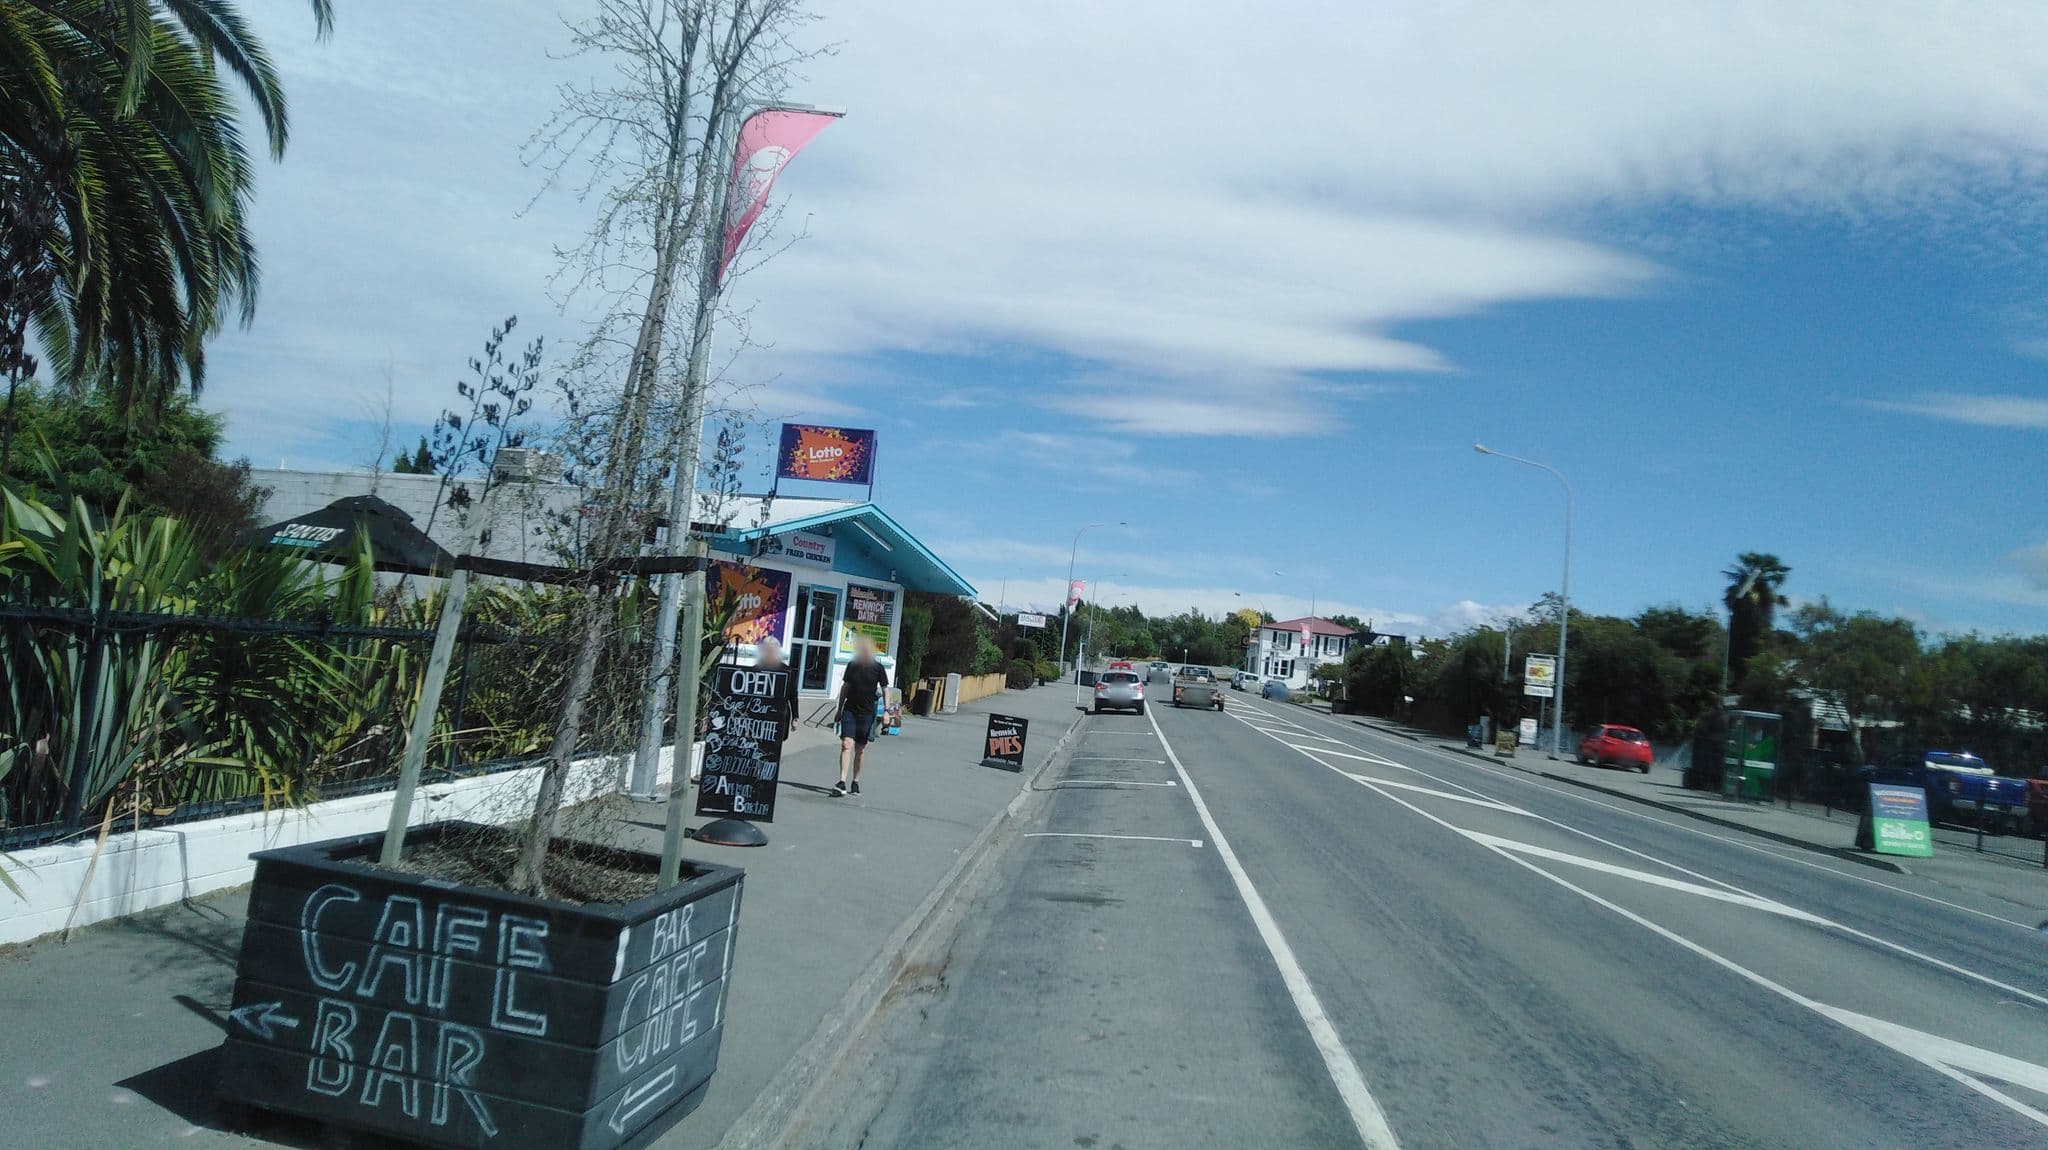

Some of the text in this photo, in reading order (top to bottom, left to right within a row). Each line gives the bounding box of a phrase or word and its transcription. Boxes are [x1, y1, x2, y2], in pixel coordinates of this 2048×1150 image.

[810, 446, 843, 459] Lotto
[793, 536, 827, 554] Country
[786, 548, 831, 564] FRIED CHICKEN
[853, 599, 886, 613] RENWICK
[857, 610, 879, 622] DAIRY
[731, 671, 776, 696] OPEN
[989, 735, 1023, 756] PIES
[650, 902, 694, 965] BAR
[301, 883, 549, 1036] CAFE
[616, 938, 708, 1074] CAFE
[306, 998, 500, 1138] BAR
